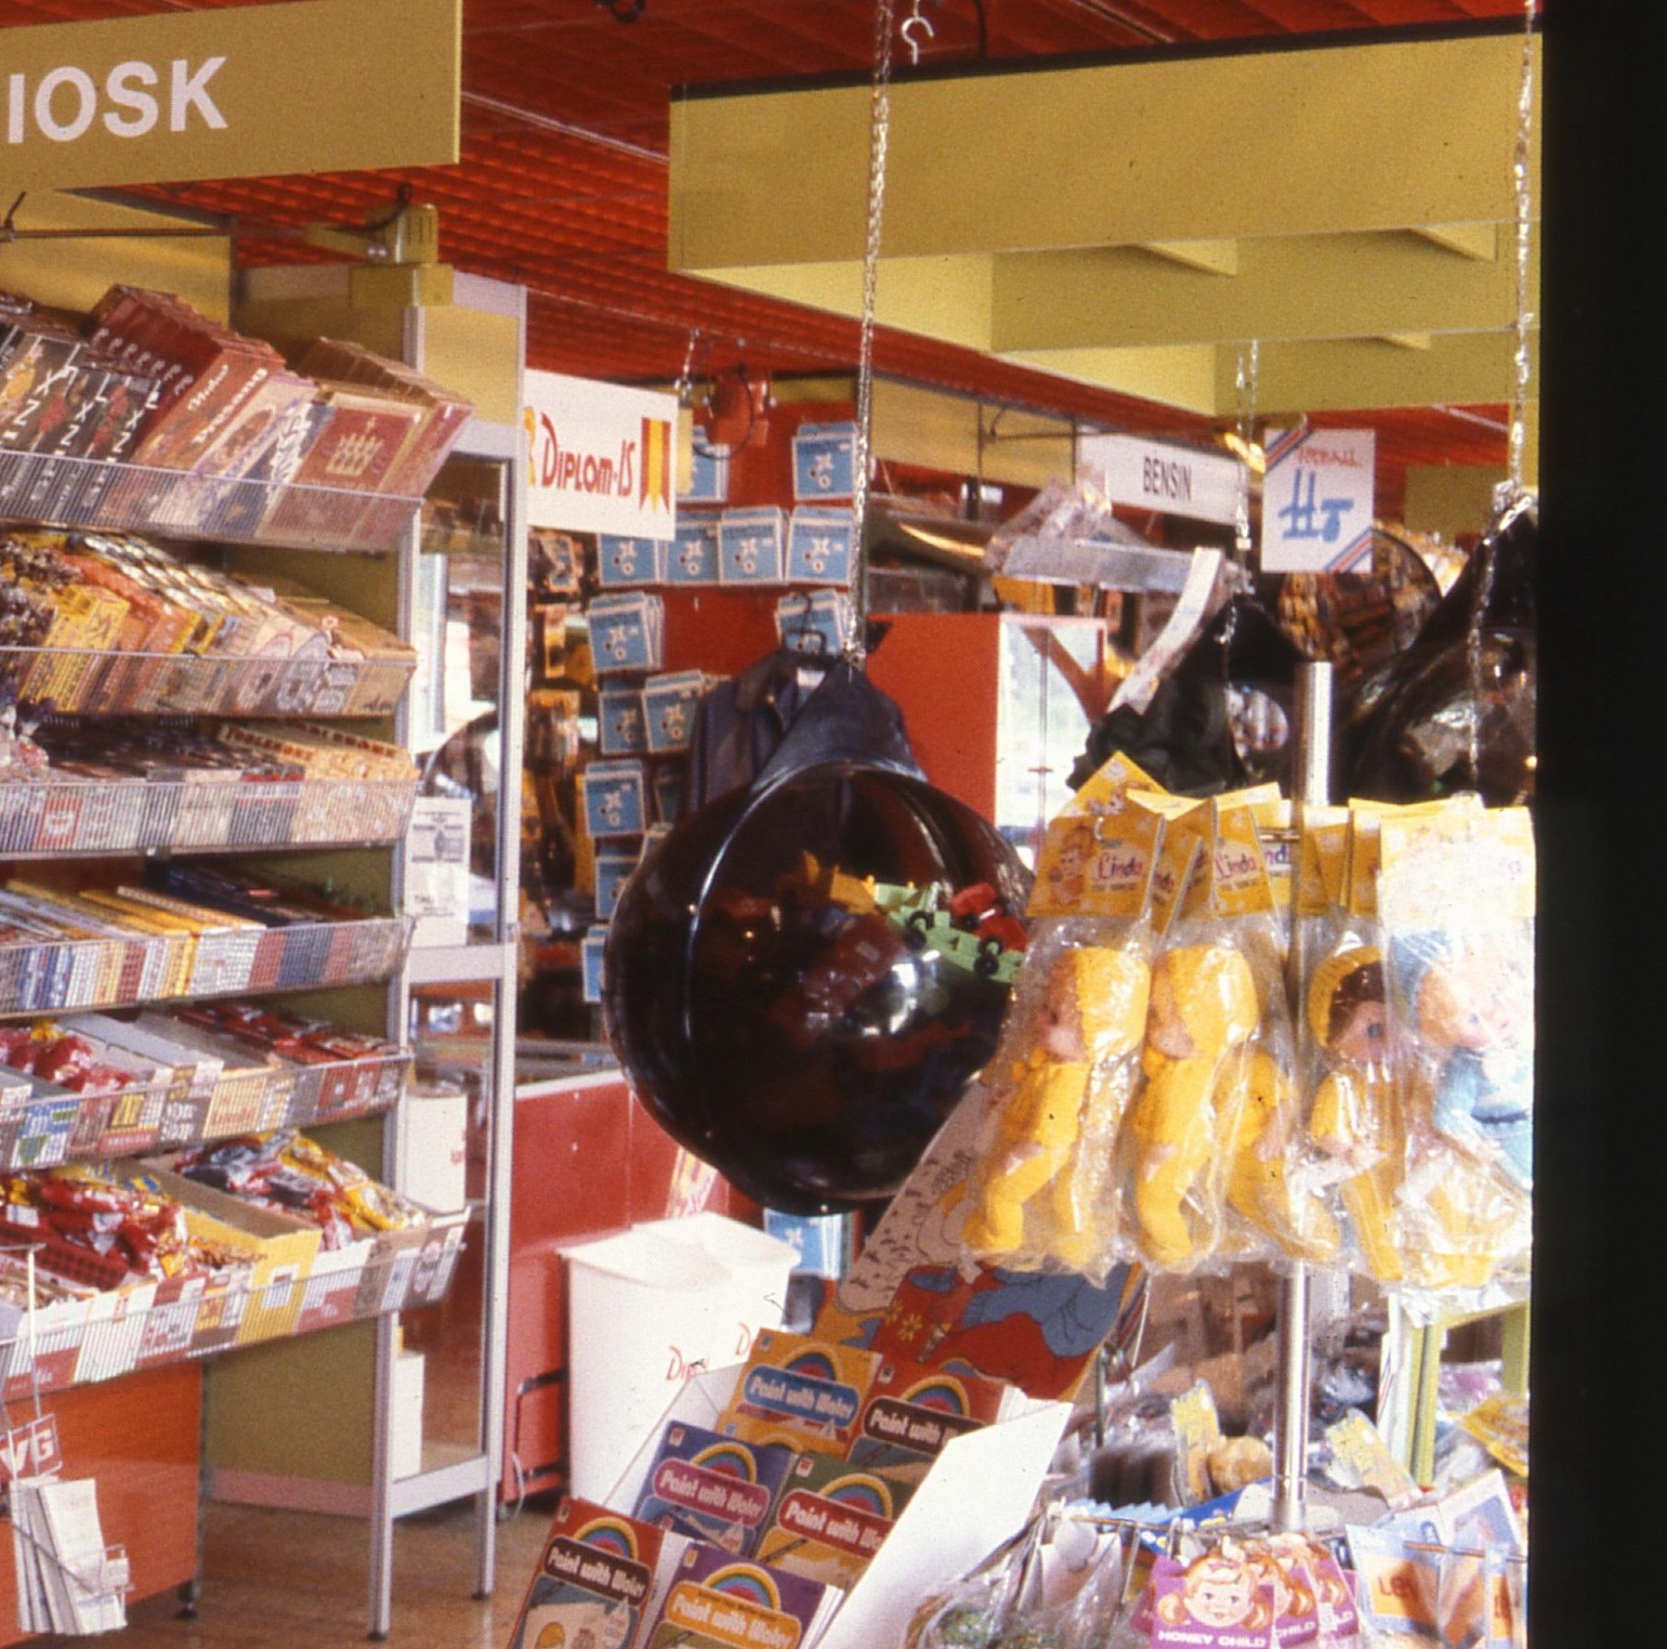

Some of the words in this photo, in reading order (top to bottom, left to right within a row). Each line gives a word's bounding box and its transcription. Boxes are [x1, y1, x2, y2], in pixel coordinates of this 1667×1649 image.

[1143, 456, 1192, 502] BENSIN
[1096, 851, 1144, 883] Linda
[749, 1376, 786, 1403] Paint
[786, 1384, 816, 1411] with
[869, 1408, 909, 1437] Paint
[908, 1419, 941, 1446] with
[659, 1470, 697, 1498] Paint
[696, 1481, 728, 1509] with
[785, 1502, 826, 1531] Paint
[826, 1515, 860, 1543] with
[545, 1544, 588, 1579] Paint
[584, 1556, 615, 1588] with
[668, 1591, 708, 1626] Paint
[707, 1602, 744, 1637] with
[1157, 1629, 1214, 1645] HONEY
[1217, 1633, 1268, 1649] CHILD
